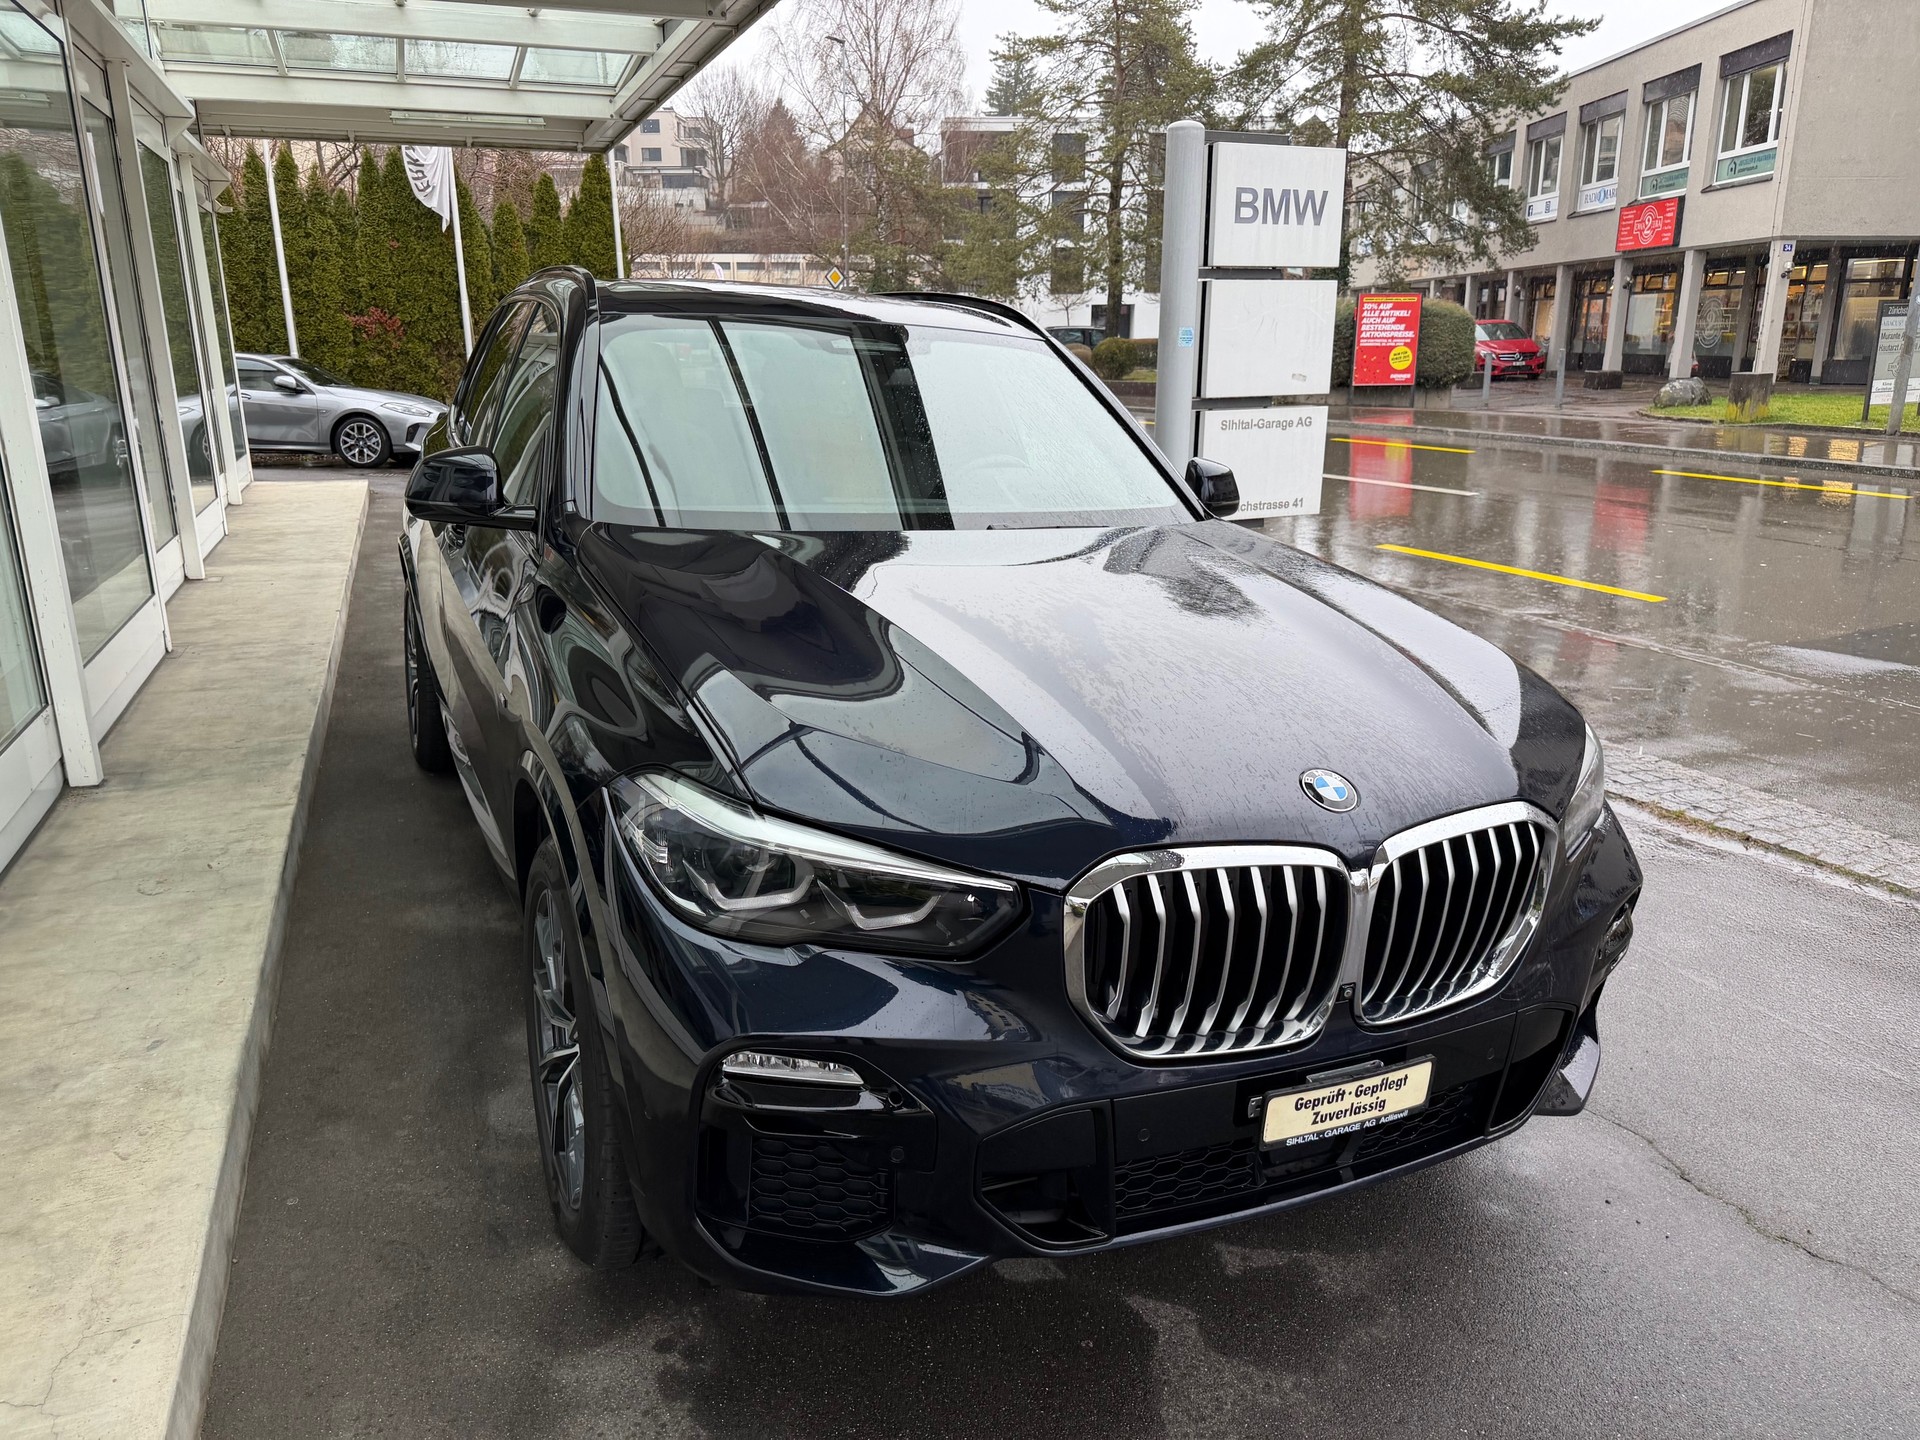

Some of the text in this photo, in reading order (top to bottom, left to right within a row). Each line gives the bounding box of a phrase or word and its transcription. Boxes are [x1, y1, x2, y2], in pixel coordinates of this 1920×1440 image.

[1234, 187, 1329, 226] BMW
[1220, 416, 1313, 431] Sihltal-Garage AG
[1238, 497, 1304, 512] chstrasse 41
[1294, 1074, 1408, 1111] Geprüft Gepflegt
[1311, 1096, 1386, 1125] Zuverlässig
[1363, 1119, 1376, 1128] AG
